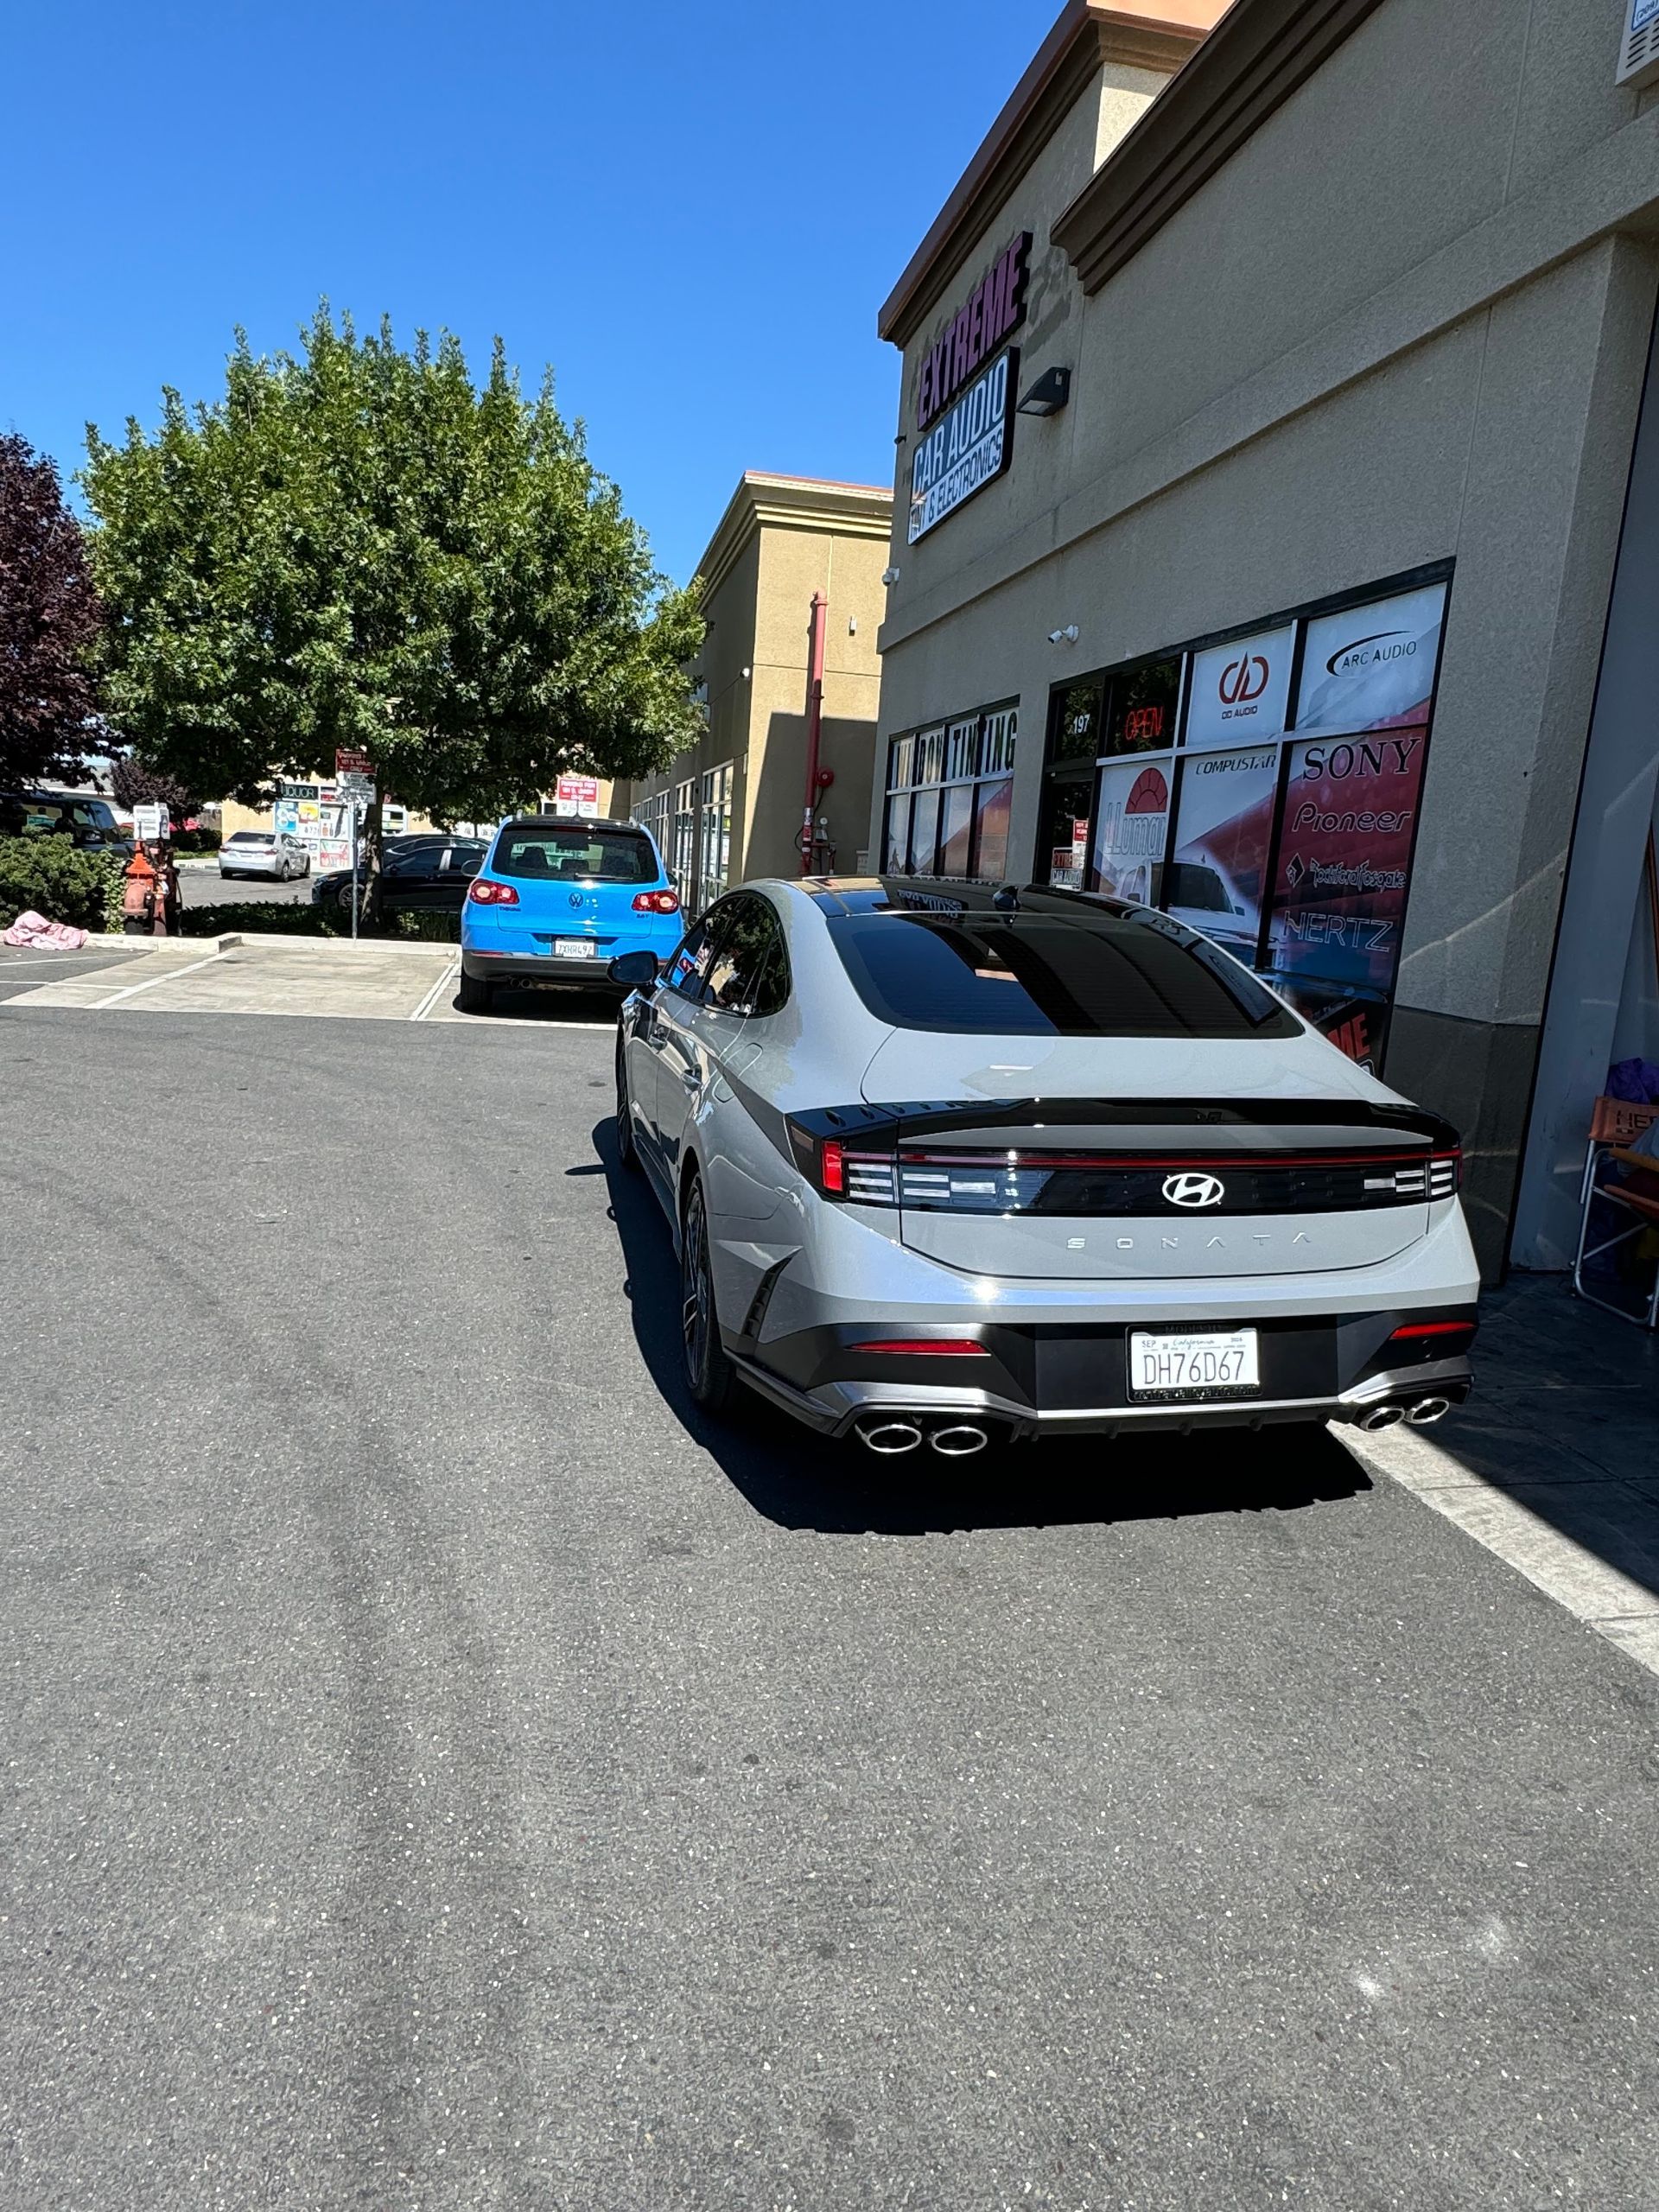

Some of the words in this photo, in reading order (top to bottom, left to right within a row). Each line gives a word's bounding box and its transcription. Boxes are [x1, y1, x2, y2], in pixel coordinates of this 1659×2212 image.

[918, 233, 1028, 431] EXTREME
[912, 423, 945, 503] CAR
[947, 355, 1007, 483] AUDIO
[928, 490, 936, 524] &
[937, 430, 1002, 517] ELECTRONICS
[1341, 652, 1370, 670] ARC
[1372, 640, 1417, 663] AUDIO
[1073, 714, 1090, 734] 197
[1124, 706, 1164, 741] OPEN
[1235, 705, 1258, 718] AUDIO
[1196, 754, 1277, 776] COMPUSTAR
[1302, 737, 1421, 782] SONY
[1292, 801, 1414, 833] Pioneer
[1283, 910, 1394, 954] HERTZ
[1067, 1232, 1310, 1249] SONATA
[1141, 1339, 1156, 1348] SEP
[1173, 1338, 1215, 1350] California
[1143, 1351, 1244, 1385] DH76D67
